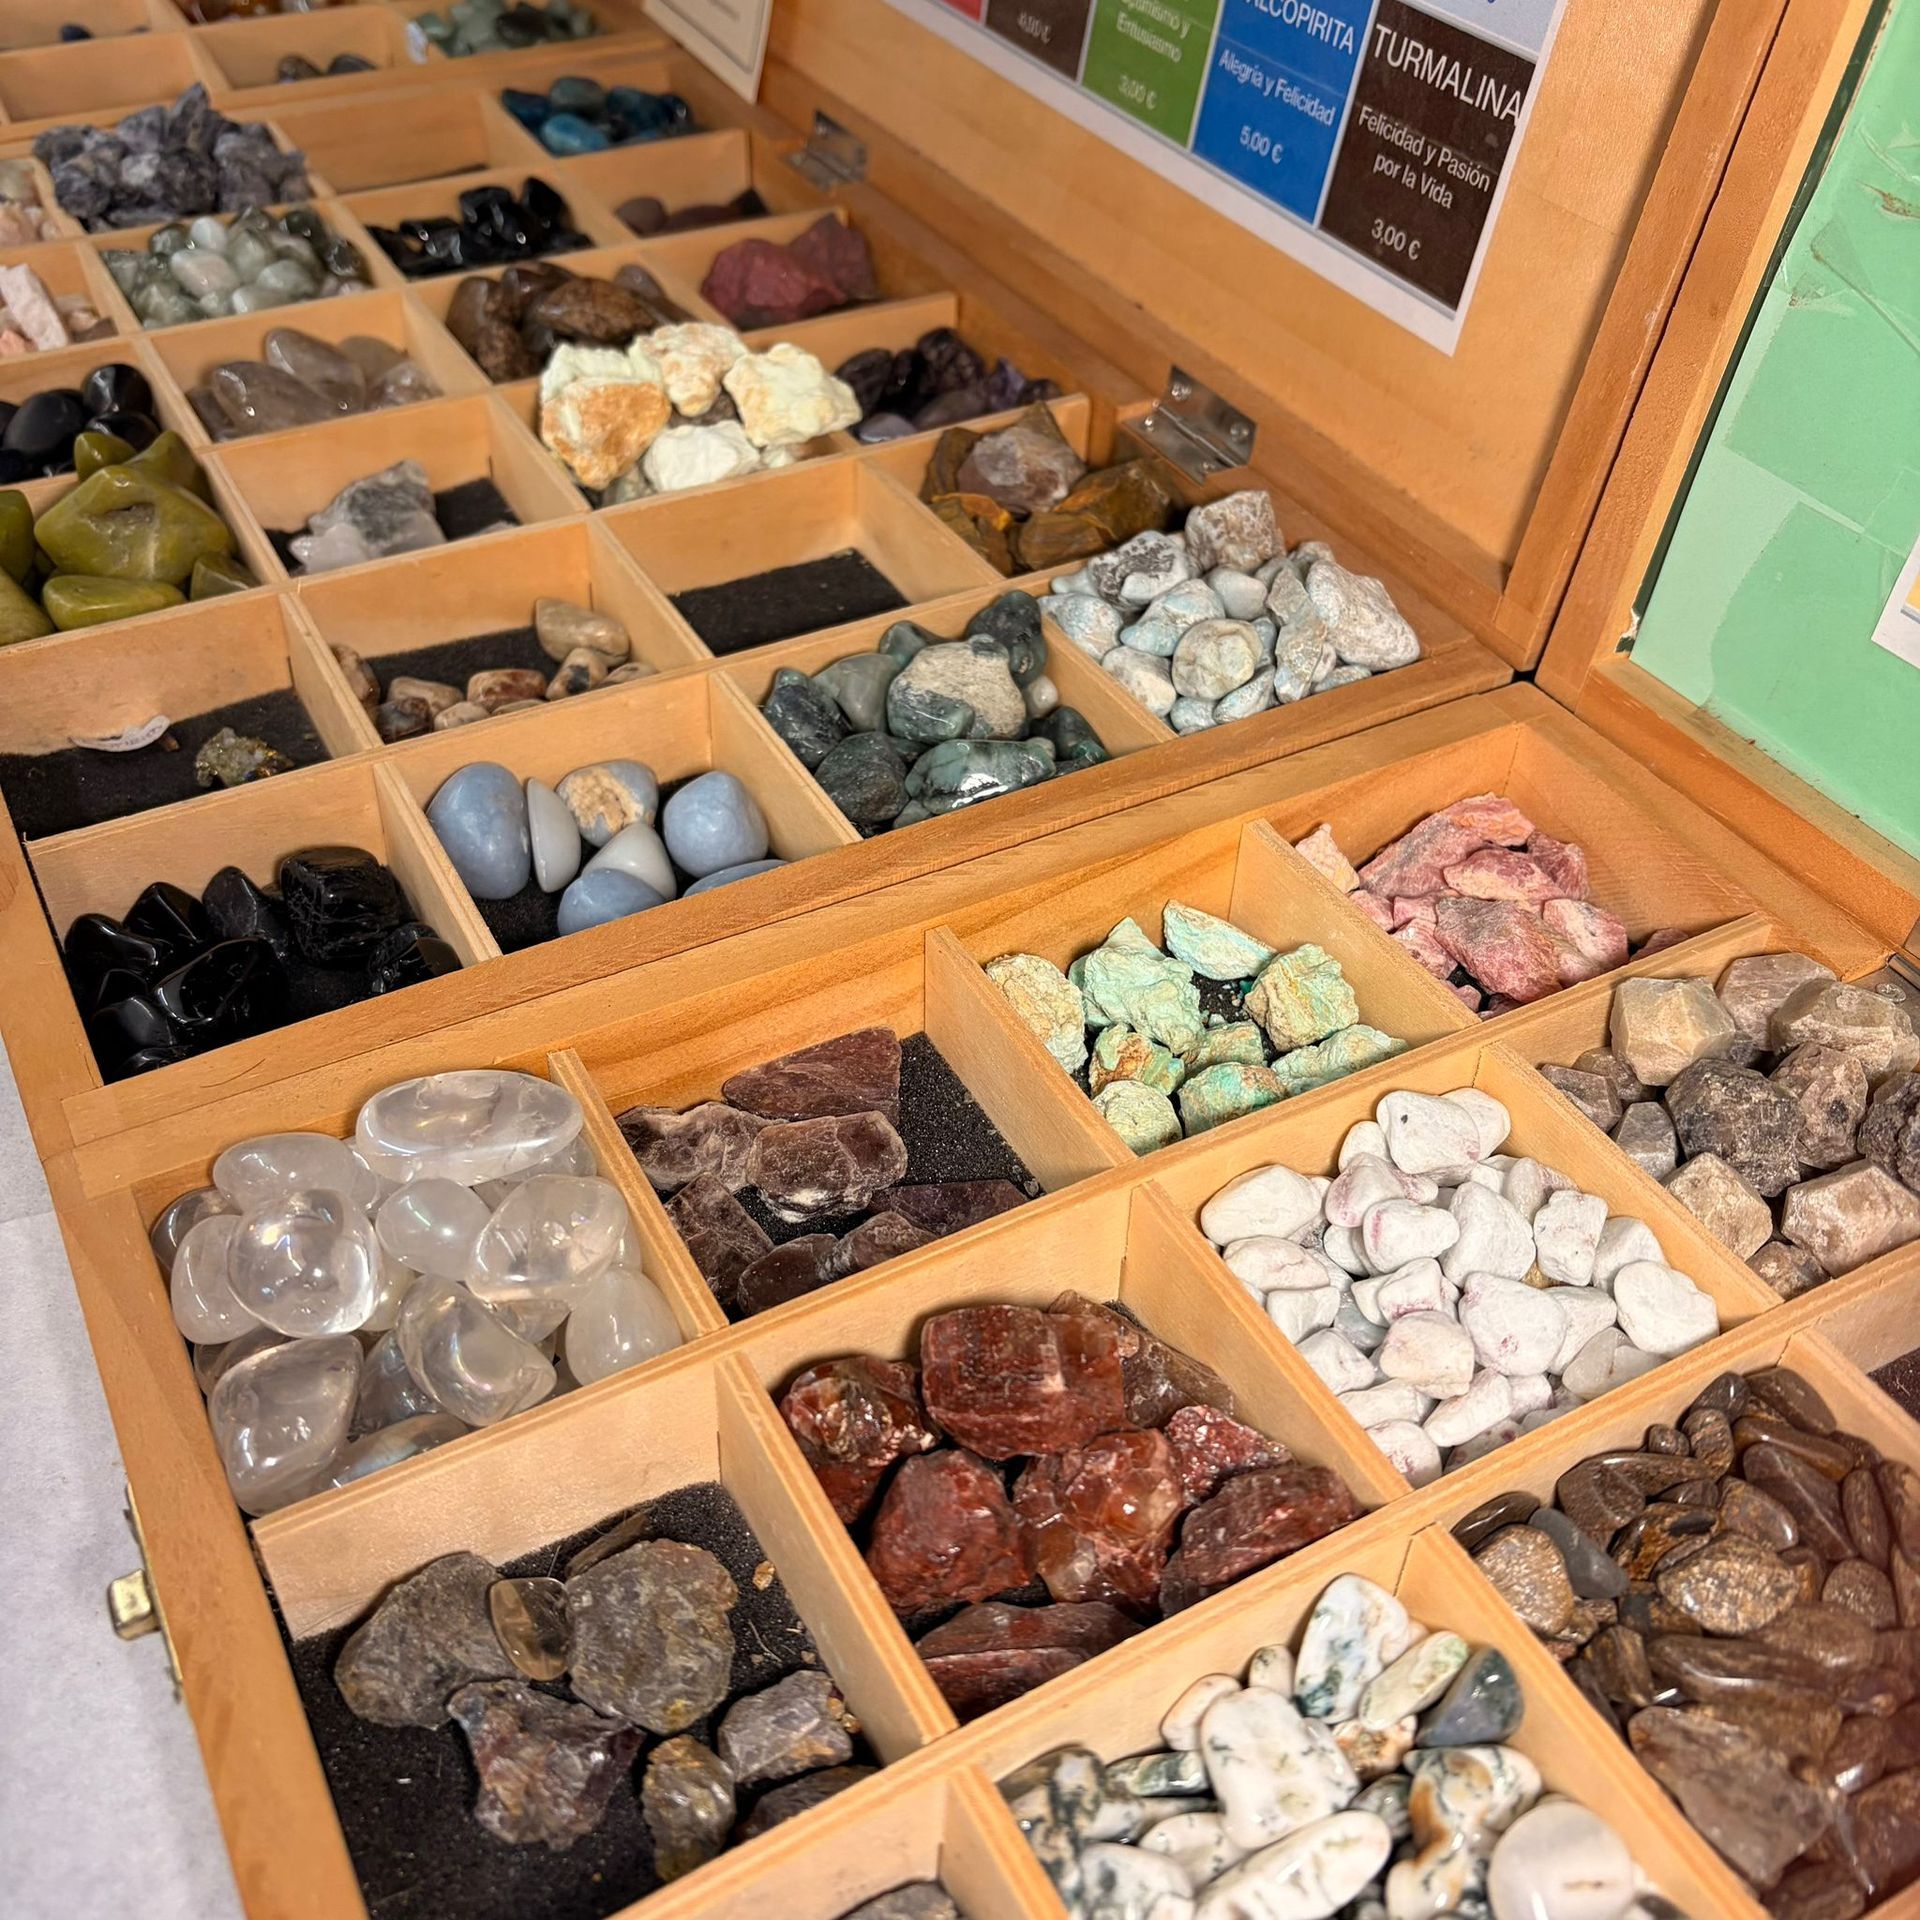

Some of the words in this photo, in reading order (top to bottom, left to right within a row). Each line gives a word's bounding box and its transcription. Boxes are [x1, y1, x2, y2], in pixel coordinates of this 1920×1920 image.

[1245, 0, 1354, 55] LCOPIRITA
[1146, 90, 1157, 110] €
[1219, 49, 1264, 86] Alegría
[1263, 73, 1274, 95] y
[1274, 78, 1337, 127] Felicidad
[1374, 23, 1523, 127] TURMALINA
[1239, 125, 1269, 158] 5,00
[1271, 142, 1283, 164] €
[1358, 106, 1425, 157] Felicidad
[1424, 143, 1436, 166] y
[1437, 147, 1491, 193] Pasión
[1373, 153, 1402, 182] por
[1401, 165, 1417, 190] la
[1420, 172, 1454, 209] Vida
[1371, 218, 1406, 252] 3,00
[1408, 239, 1421, 261] €
